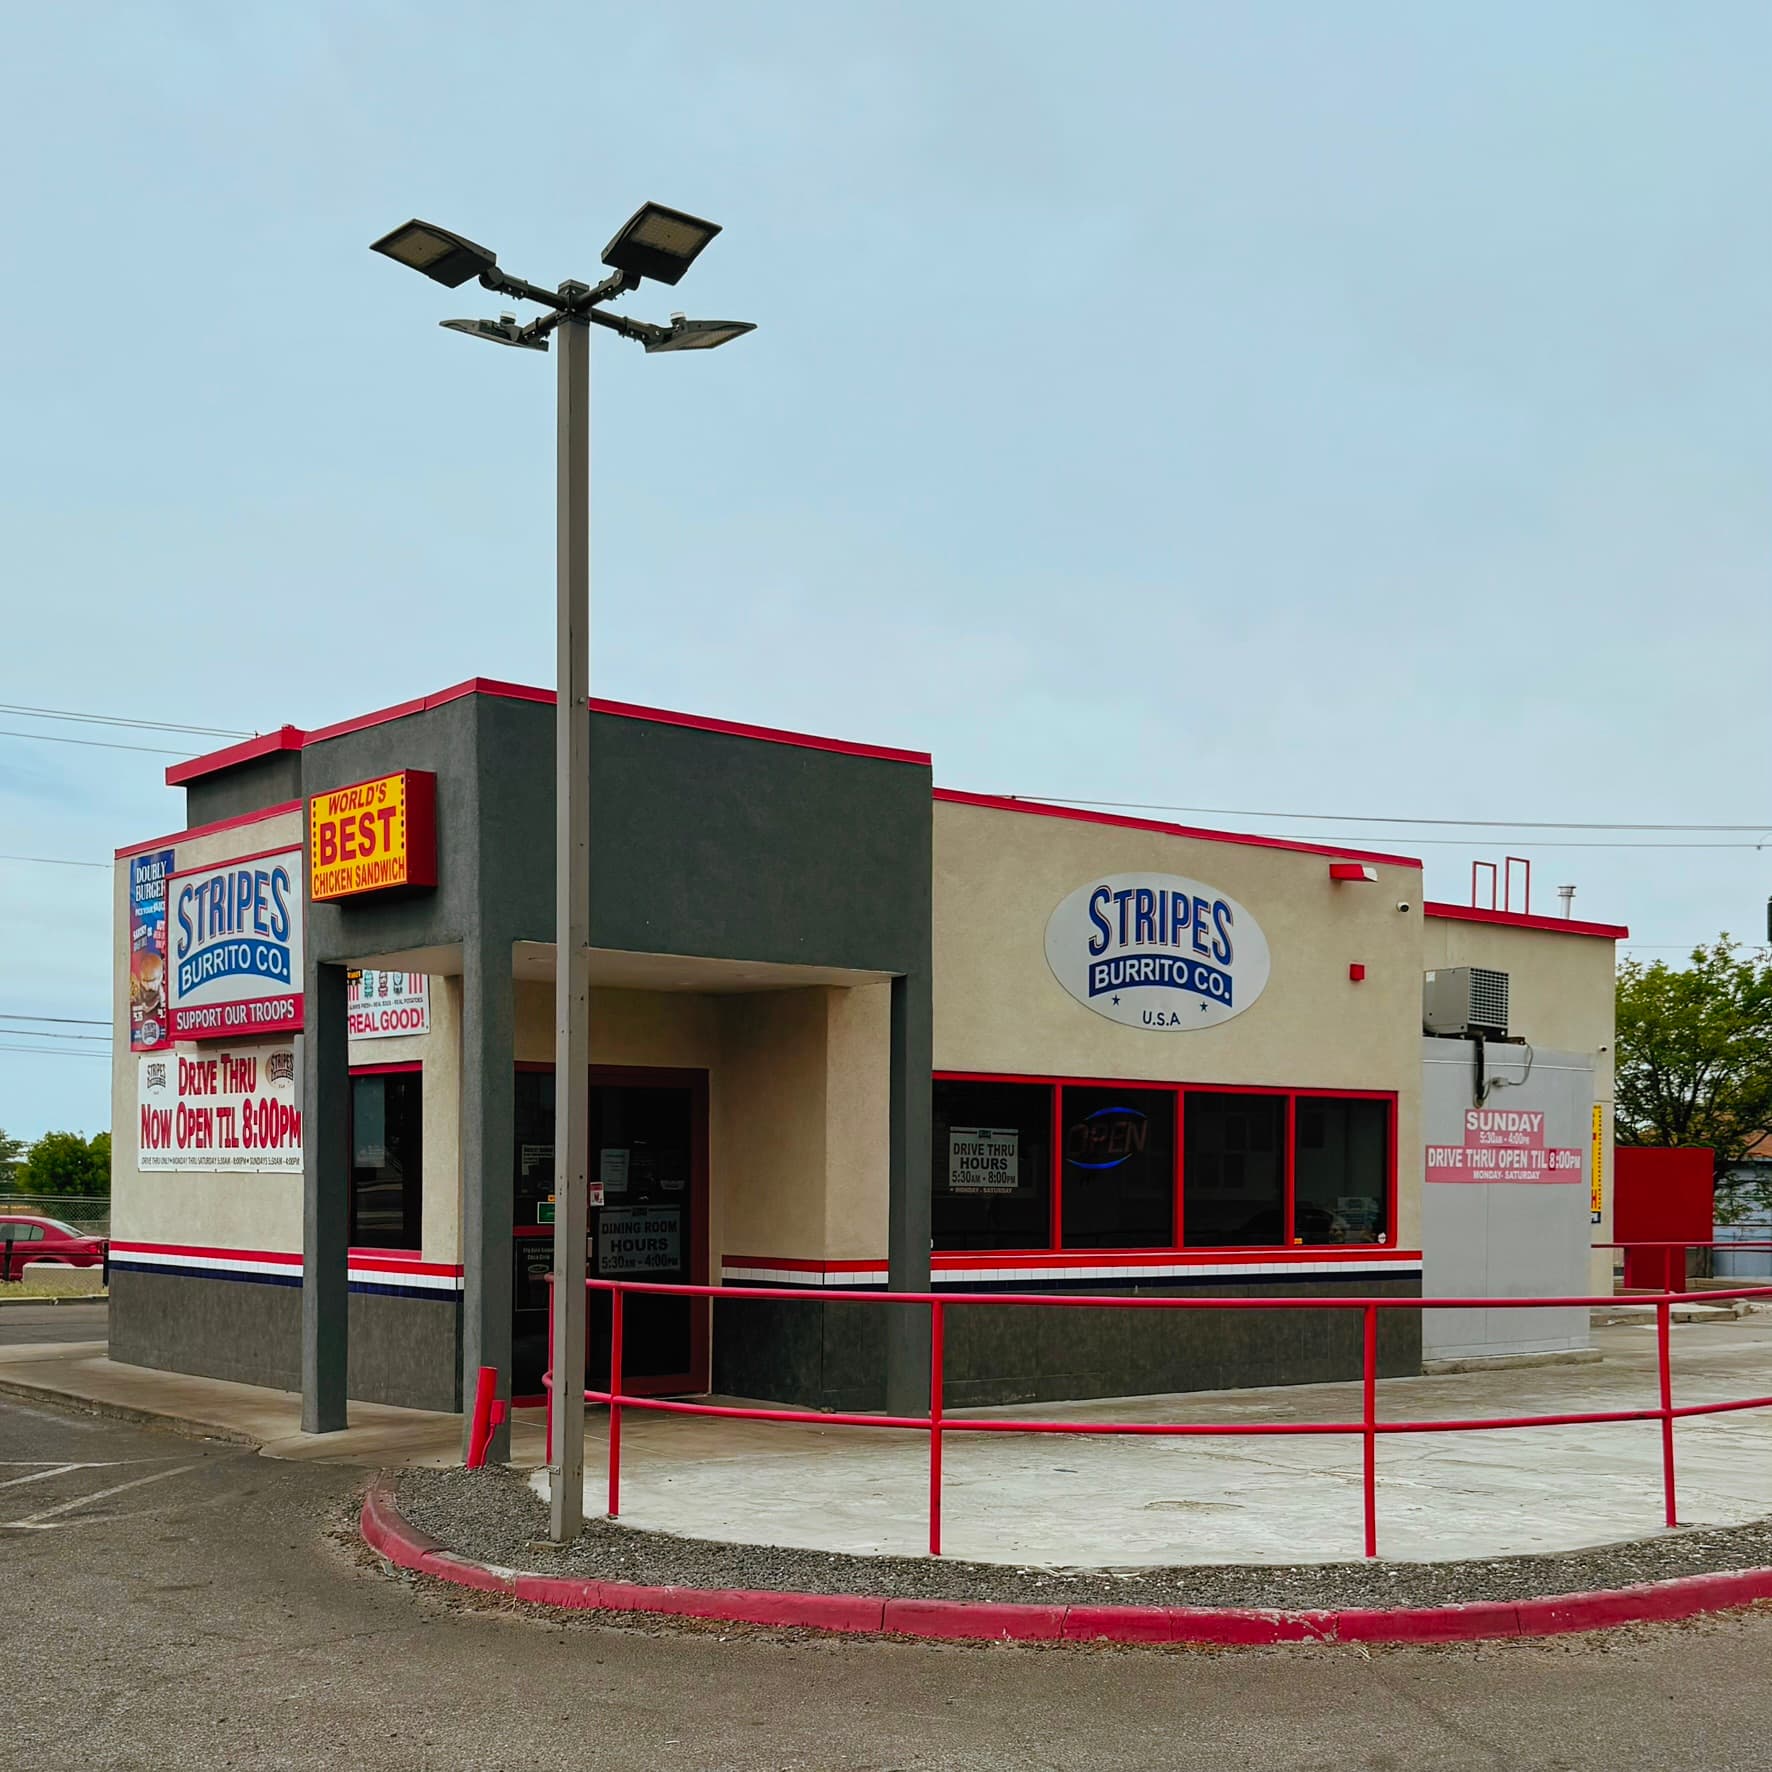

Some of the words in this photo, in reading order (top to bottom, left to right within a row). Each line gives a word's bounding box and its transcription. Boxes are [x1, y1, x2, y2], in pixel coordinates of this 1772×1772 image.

[328, 782, 387, 816] WORLD'S
[320, 806, 397, 866] BEST
[313, 867, 353, 896] CHICKEN
[355, 856, 405, 887] SANDWICH
[177, 865, 291, 960] STRIPES
[1088, 884, 1233, 966] STRIPES
[182, 944, 251, 991] BURRITO
[256, 946, 288, 976] CO.
[1094, 958, 1188, 989] BURRITO
[1194, 968, 1230, 999] CO.
[177, 1007, 222, 1030] SUPPORT
[224, 1005, 247, 1025] OUR
[250, 999, 294, 1022] TROOPS
[349, 1012, 379, 1034] REAL
[380, 1007, 424, 1031] GOOD!
[178, 1057, 217, 1096] DRIVE
[220, 1053, 257, 1094] THRU
[141, 1104, 173, 1149] NOW
[176, 1101, 213, 1150] OPEN
[216, 1107, 240, 1148] TIL
[242, 1097, 302, 1149] 8:00PM
[1068, 1119, 1148, 1152] OPEN
[1466, 1112, 1543, 1132] SUNDAY
[953, 1142, 985, 1156] DRIVE
[987, 1143, 1015, 1157] THRU
[960, 1157, 1008, 1170] HOURS
[1428, 1149, 1463, 1167] DRIVE
[1465, 1149, 1496, 1168] THRU
[1499, 1150, 1528, 1169] OPEN
[1531, 1151, 1548, 1169] TIL
[1549, 1151, 1581, 1169] 8:00PM
[952, 1170, 981, 1184] 5:30AM
[988, 1171, 1016, 1184] 8:00PM
[1504, 1170, 1540, 1180] SATURDAY
[601, 1222, 641, 1234] DINING
[645, 1219, 678, 1233] ROOM
[610, 1238, 668, 1253] HOURS
